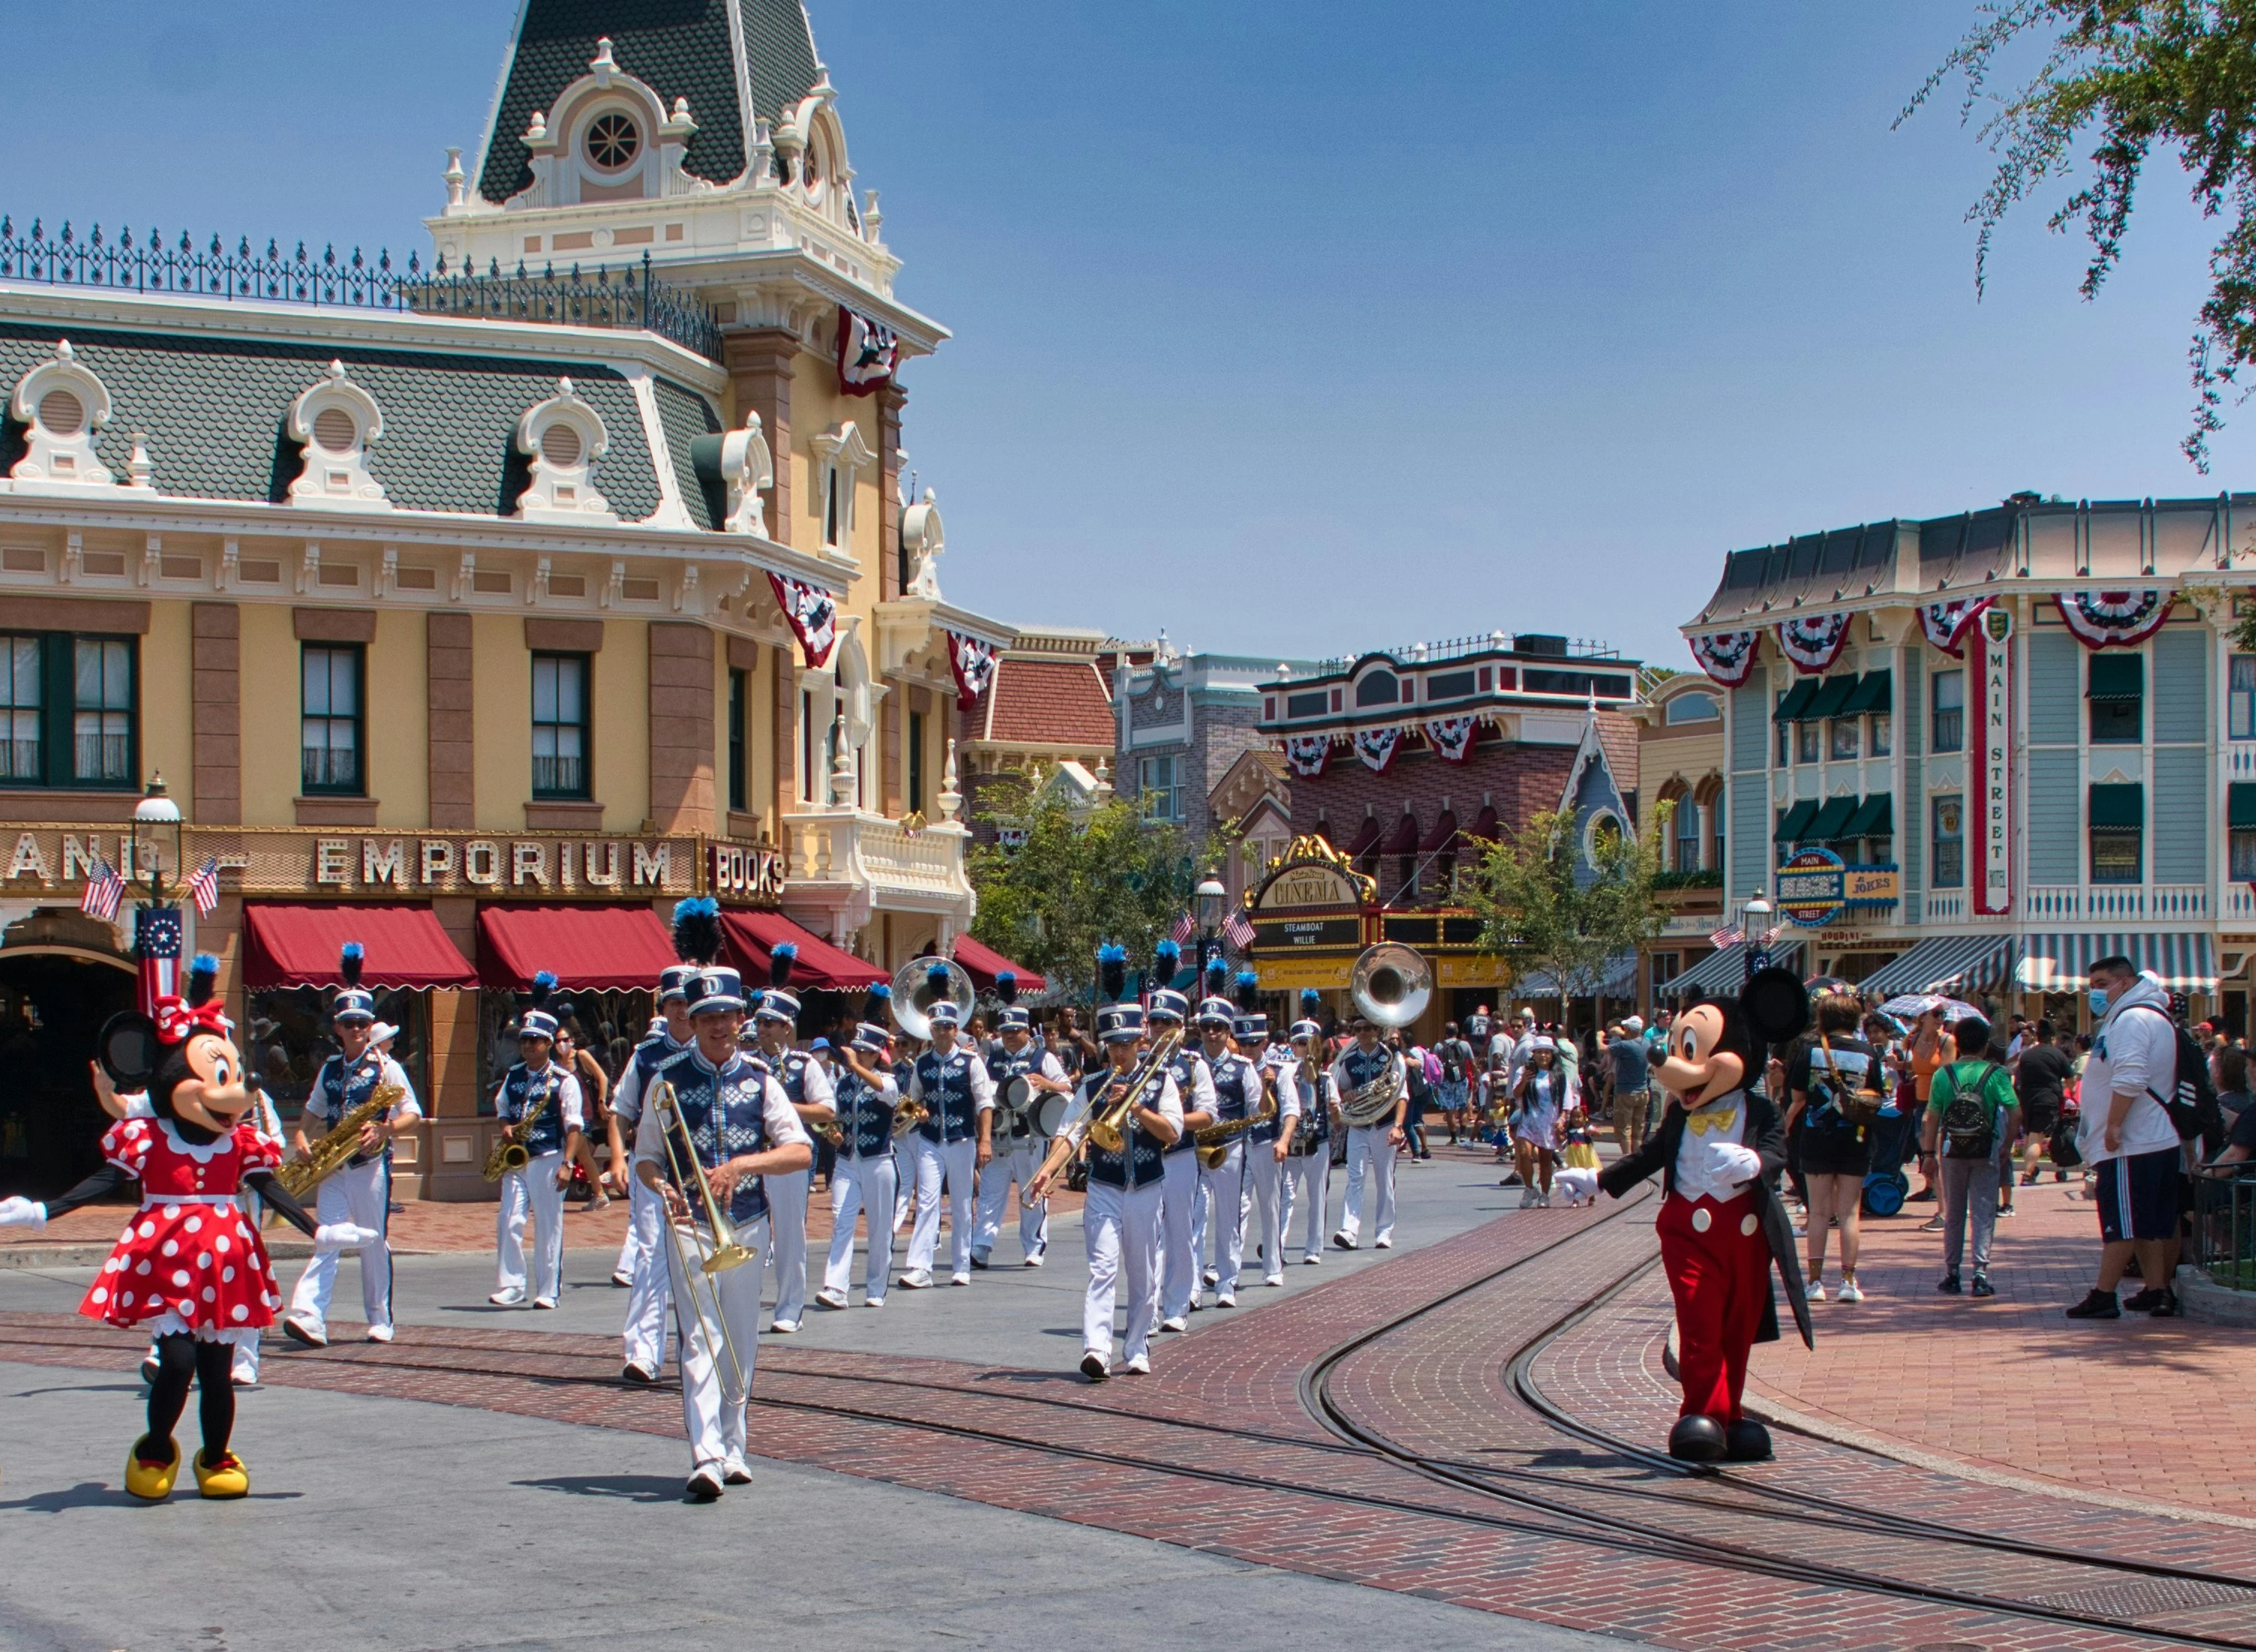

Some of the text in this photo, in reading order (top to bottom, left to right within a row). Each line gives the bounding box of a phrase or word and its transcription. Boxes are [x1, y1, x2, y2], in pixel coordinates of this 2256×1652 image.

[1989, 653, 2003, 859] MAIN STREET
[314, 838, 671, 886] EMPORIUM
[714, 845, 785, 894] BOOKS
[1800, 857, 1819, 866] MAIN
[1273, 878, 1342, 905] CINEMA
[1798, 909, 1820, 919] STREET
[1284, 922, 1324, 933] STEAMBOAT
[1293, 935, 1316, 944] WILLIE
[1821, 931, 1859, 941] HOUDINI
[702, 975, 723, 994] D
[1110, 1012, 1127, 1028] D
